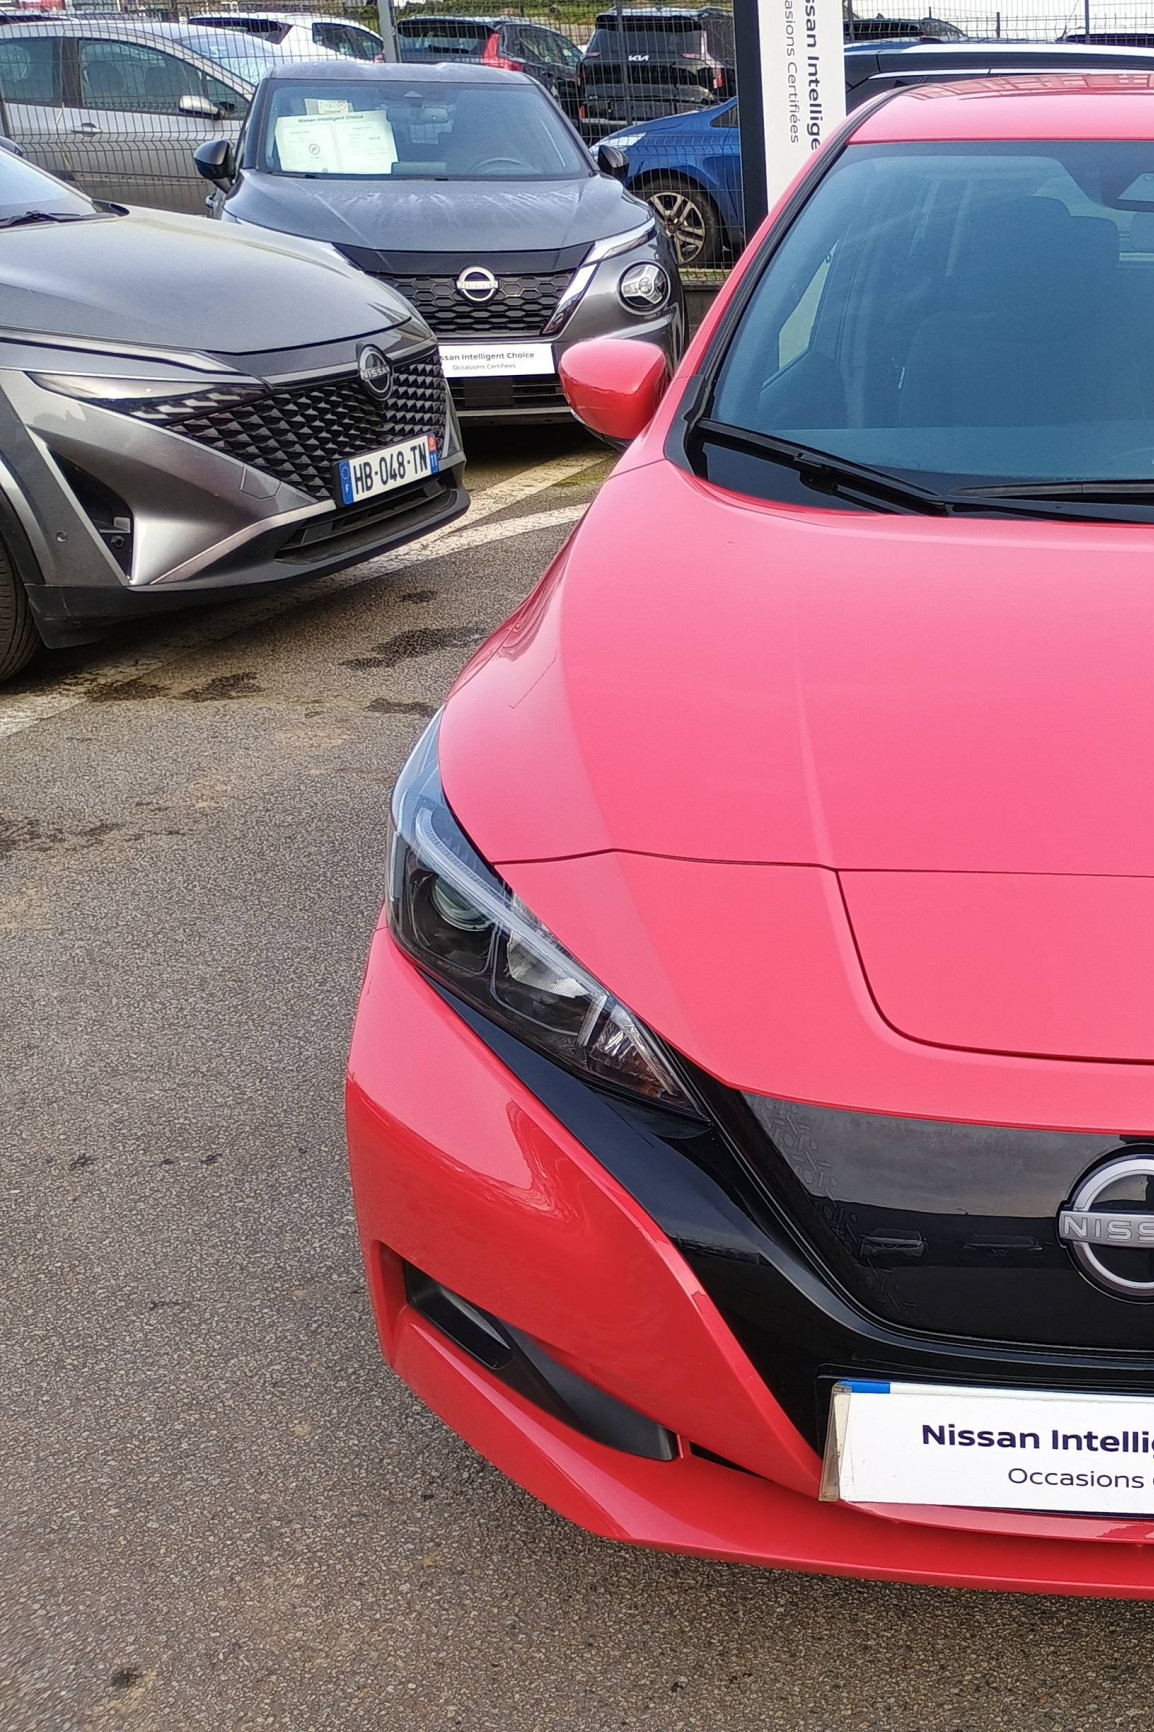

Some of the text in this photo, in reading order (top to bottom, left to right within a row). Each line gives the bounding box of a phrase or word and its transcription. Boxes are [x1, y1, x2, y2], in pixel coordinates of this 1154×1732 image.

[805, 0, 818, 48] san
[628, 54, 649, 62] KIA
[787, 62, 801, 143] Certifiées
[461, 352, 505, 361] Intelligent
[506, 351, 535, 359] Choice
[362, 366, 391, 379] NISSAN
[353, 442, 428, 495] HB-048-TN
[430, 453, 438, 468] 11
[922, 1424, 1040, 1449] Nissan
[1007, 1468, 1145, 1489] Occasions
